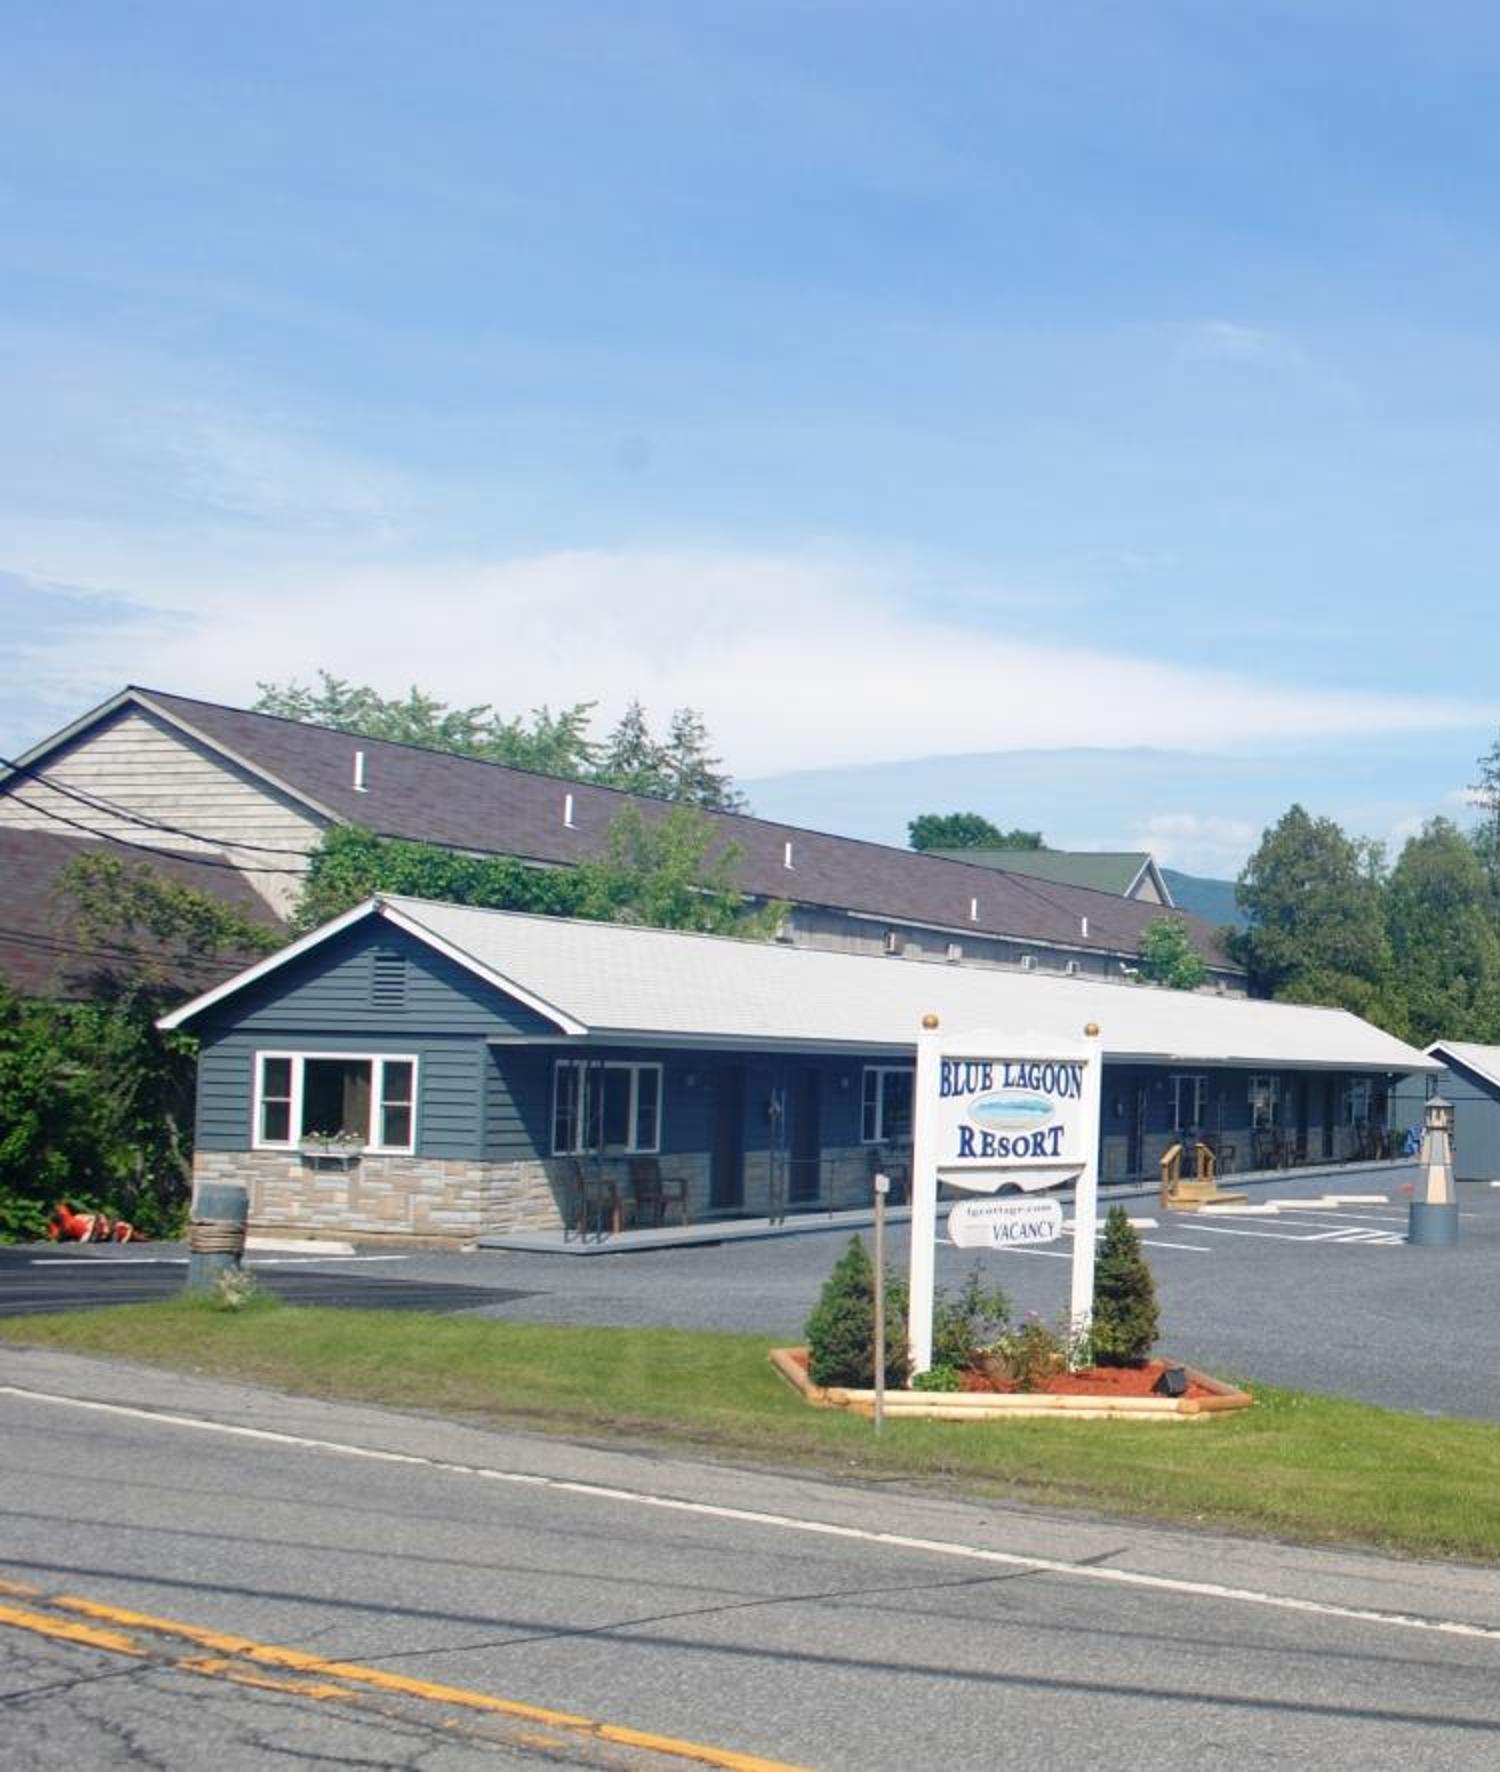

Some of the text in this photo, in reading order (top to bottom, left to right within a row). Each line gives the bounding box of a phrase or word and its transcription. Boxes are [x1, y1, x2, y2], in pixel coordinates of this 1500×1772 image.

[939, 1060, 1084, 1099] BLUE LAGOON
[956, 1124, 1065, 1158] RESORT
[993, 1221, 1055, 1241] VACANCY
